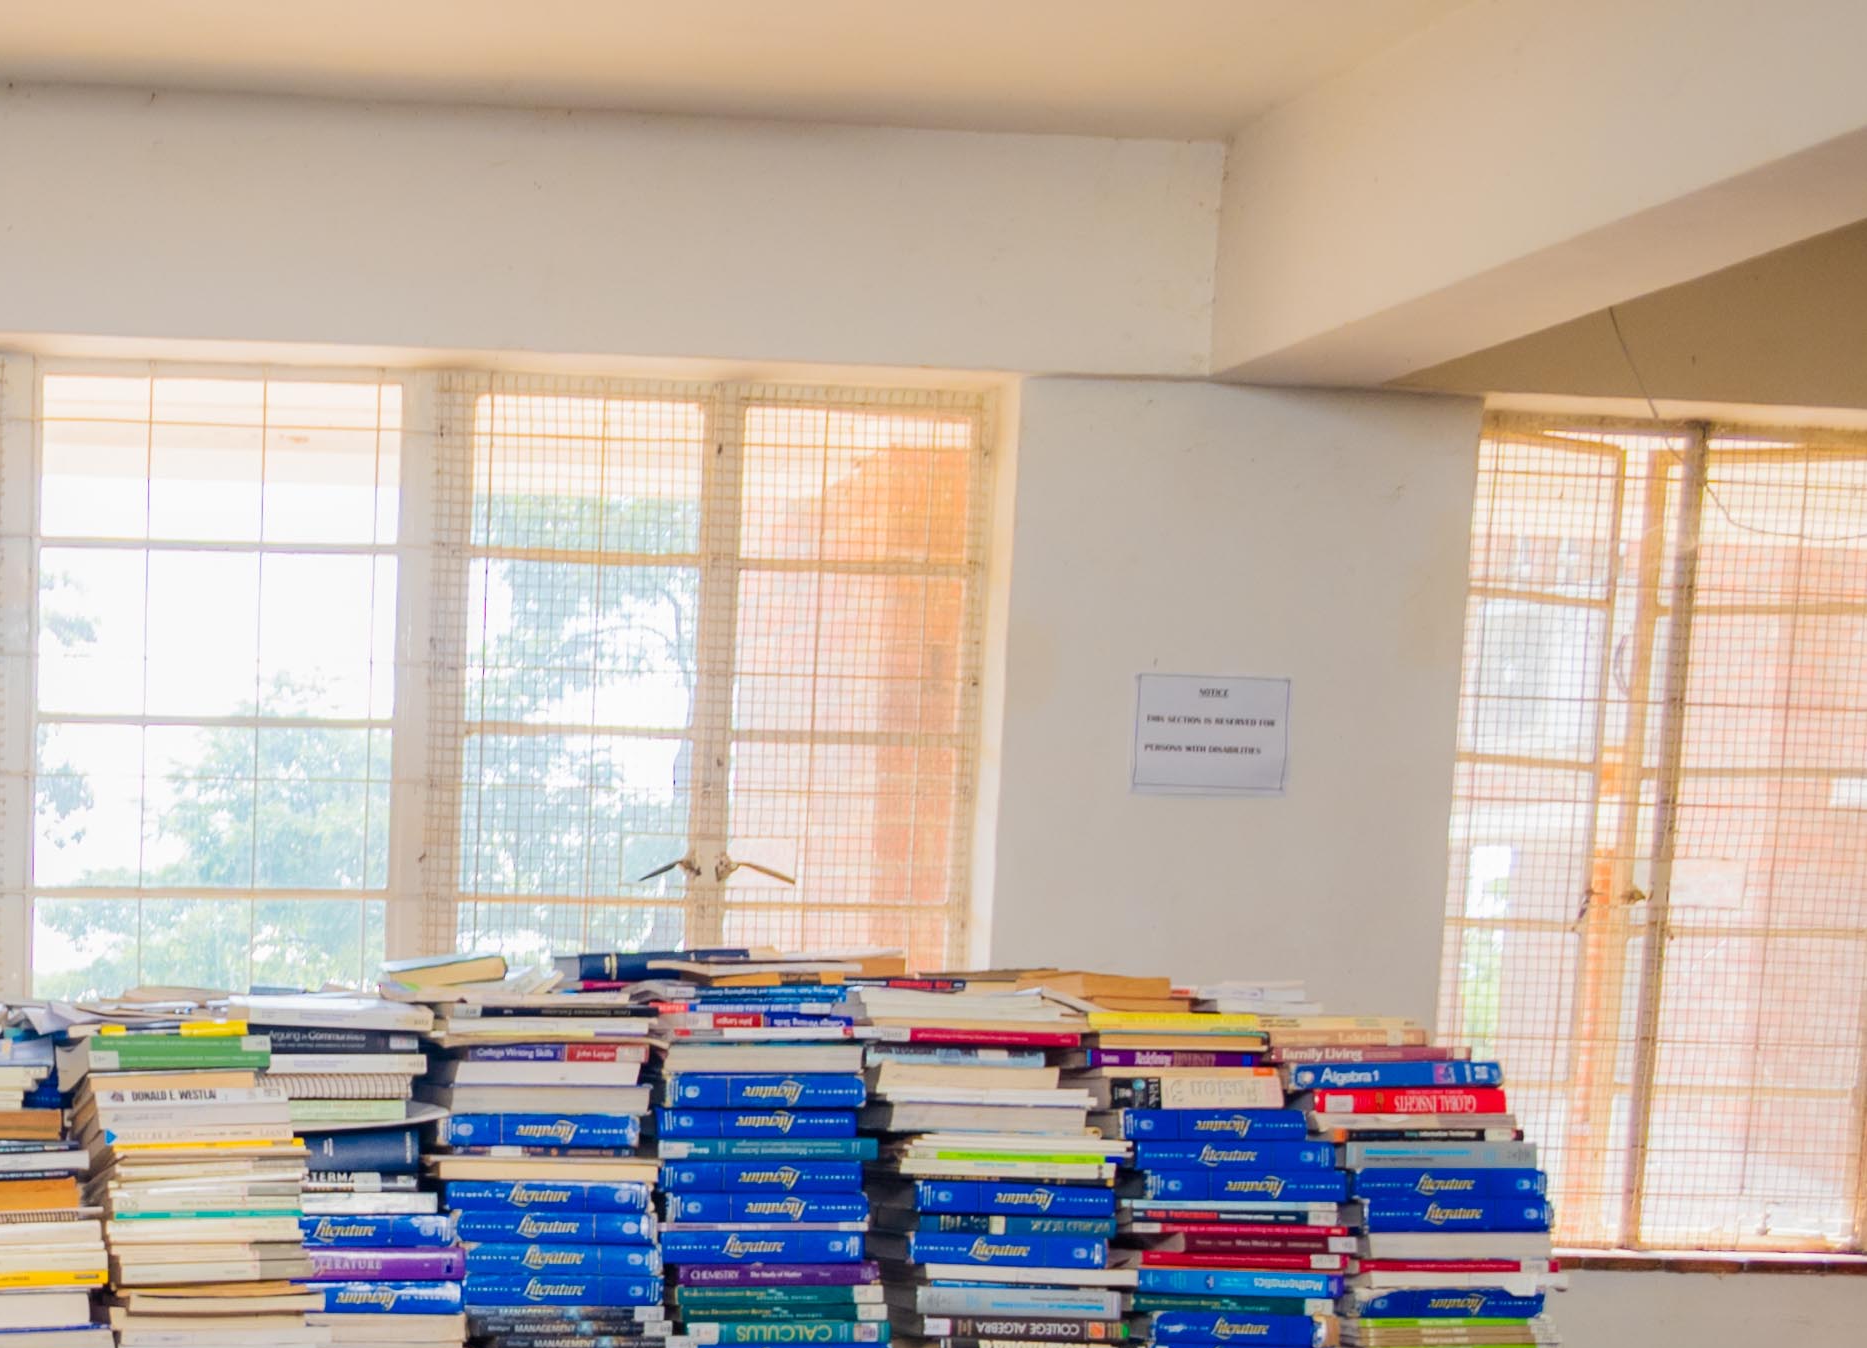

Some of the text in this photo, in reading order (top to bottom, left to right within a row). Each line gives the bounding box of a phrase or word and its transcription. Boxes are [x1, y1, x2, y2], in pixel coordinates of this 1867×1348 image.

[1198, 688, 1229, 698] NOTICE
[1147, 714, 1165, 723] THIS
[1167, 715, 1201, 725] SECTION
[1214, 717, 1257, 727] RESERVED
[1144, 743, 1261, 755] PERSONS WITH DISABILITIES
[506, 1049, 535, 1061] Writing
[1282, 1047, 1363, 1063] Family Living
[1321, 1068, 1380, 1084] Algebra 1
[131, 1089, 167, 1101] DONALD
[742, 1079, 805, 1106] Literature
[1393, 1093, 1477, 1113] GLOBAL INSIGHTS
[515, 1119, 578, 1144] Literature
[735, 1110, 796, 1134] Literature
[1194, 1115, 1252, 1138] Literature
[1198, 1144, 1257, 1167] Literature
[738, 1166, 801, 1191] Literature
[1225, 1176, 1285, 1199] Literature
[1415, 1173, 1475, 1196] Literature
[507, 1182, 571, 1207] Literature
[994, 1188, 1054, 1211] Literature
[744, 1197, 807, 1221] Literature
[1423, 1201, 1483, 1225] Literature
[313, 1219, 376, 1243] Literature
[516, 1213, 580, 1238] Literature
[722, 1233, 785, 1258] Literature
[968, 1236, 1030, 1261] Literature
[521, 1245, 585, 1270] Literature
[690, 1270, 740, 1280] CHEMISTRY
[1254, 1277, 1324, 1291] Mathematics
[336, 1287, 399, 1311] Literature
[522, 1277, 586, 1301] Literature
[1428, 1293, 1487, 1315] Literature
[736, 1325, 833, 1343] CALCULUS
[975, 1321, 1080, 1335] COLLEGE ALGEBRA
[1210, 1317, 1270, 1340] Literature
[533, 1339, 596, 1348] MANAGEMENT
